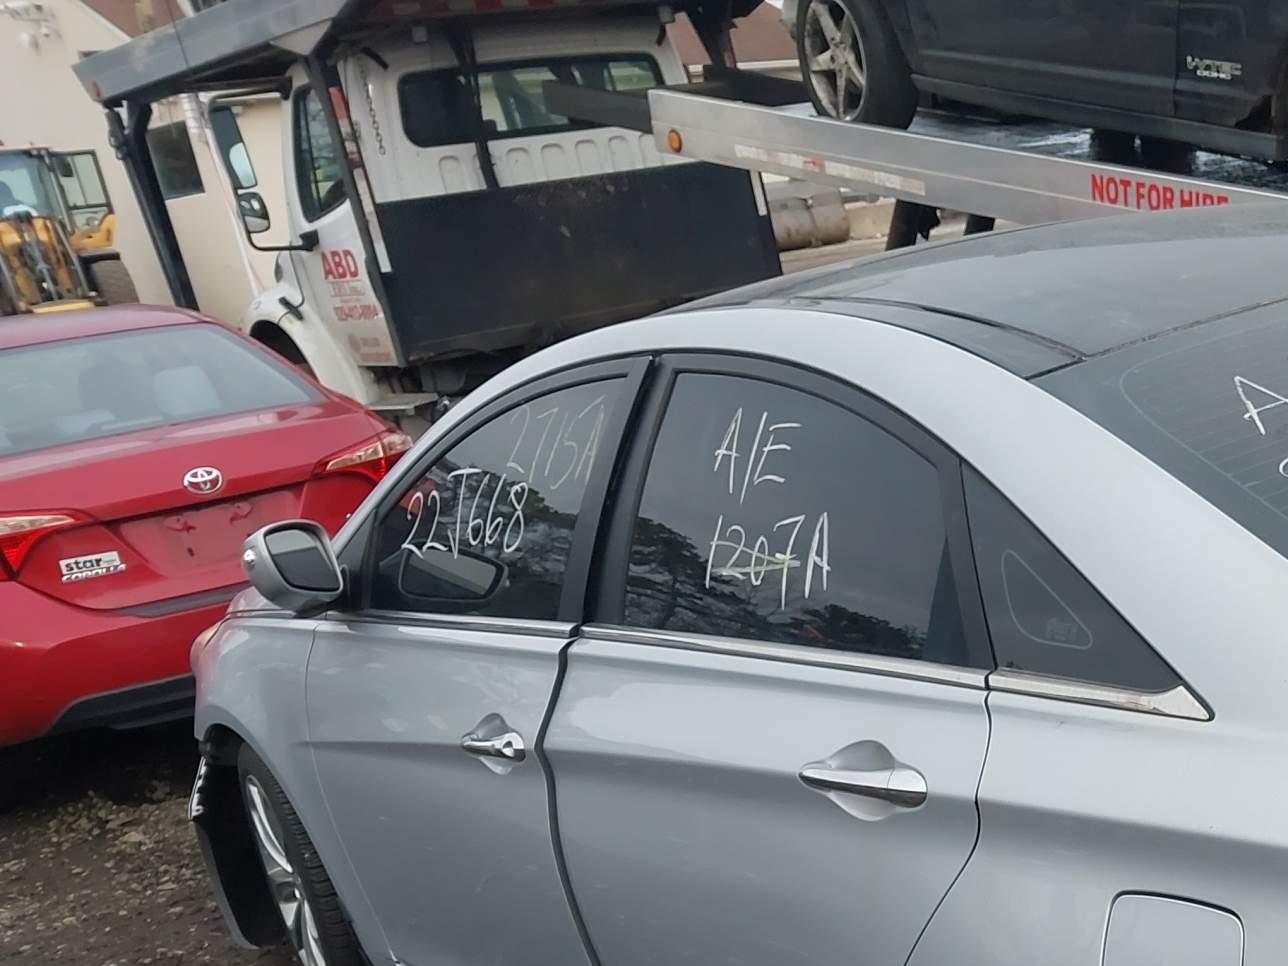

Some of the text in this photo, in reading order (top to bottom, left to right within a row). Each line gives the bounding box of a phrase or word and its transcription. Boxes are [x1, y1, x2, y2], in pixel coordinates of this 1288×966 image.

[1091, 173, 1132, 208] NOT
[1135, 182, 1175, 211] FOR
[321, 249, 359, 281] ABD
[713, 407, 803, 505] A/E
[64, 557, 102, 573] star
[705, 511, 831, 611] 1207A
